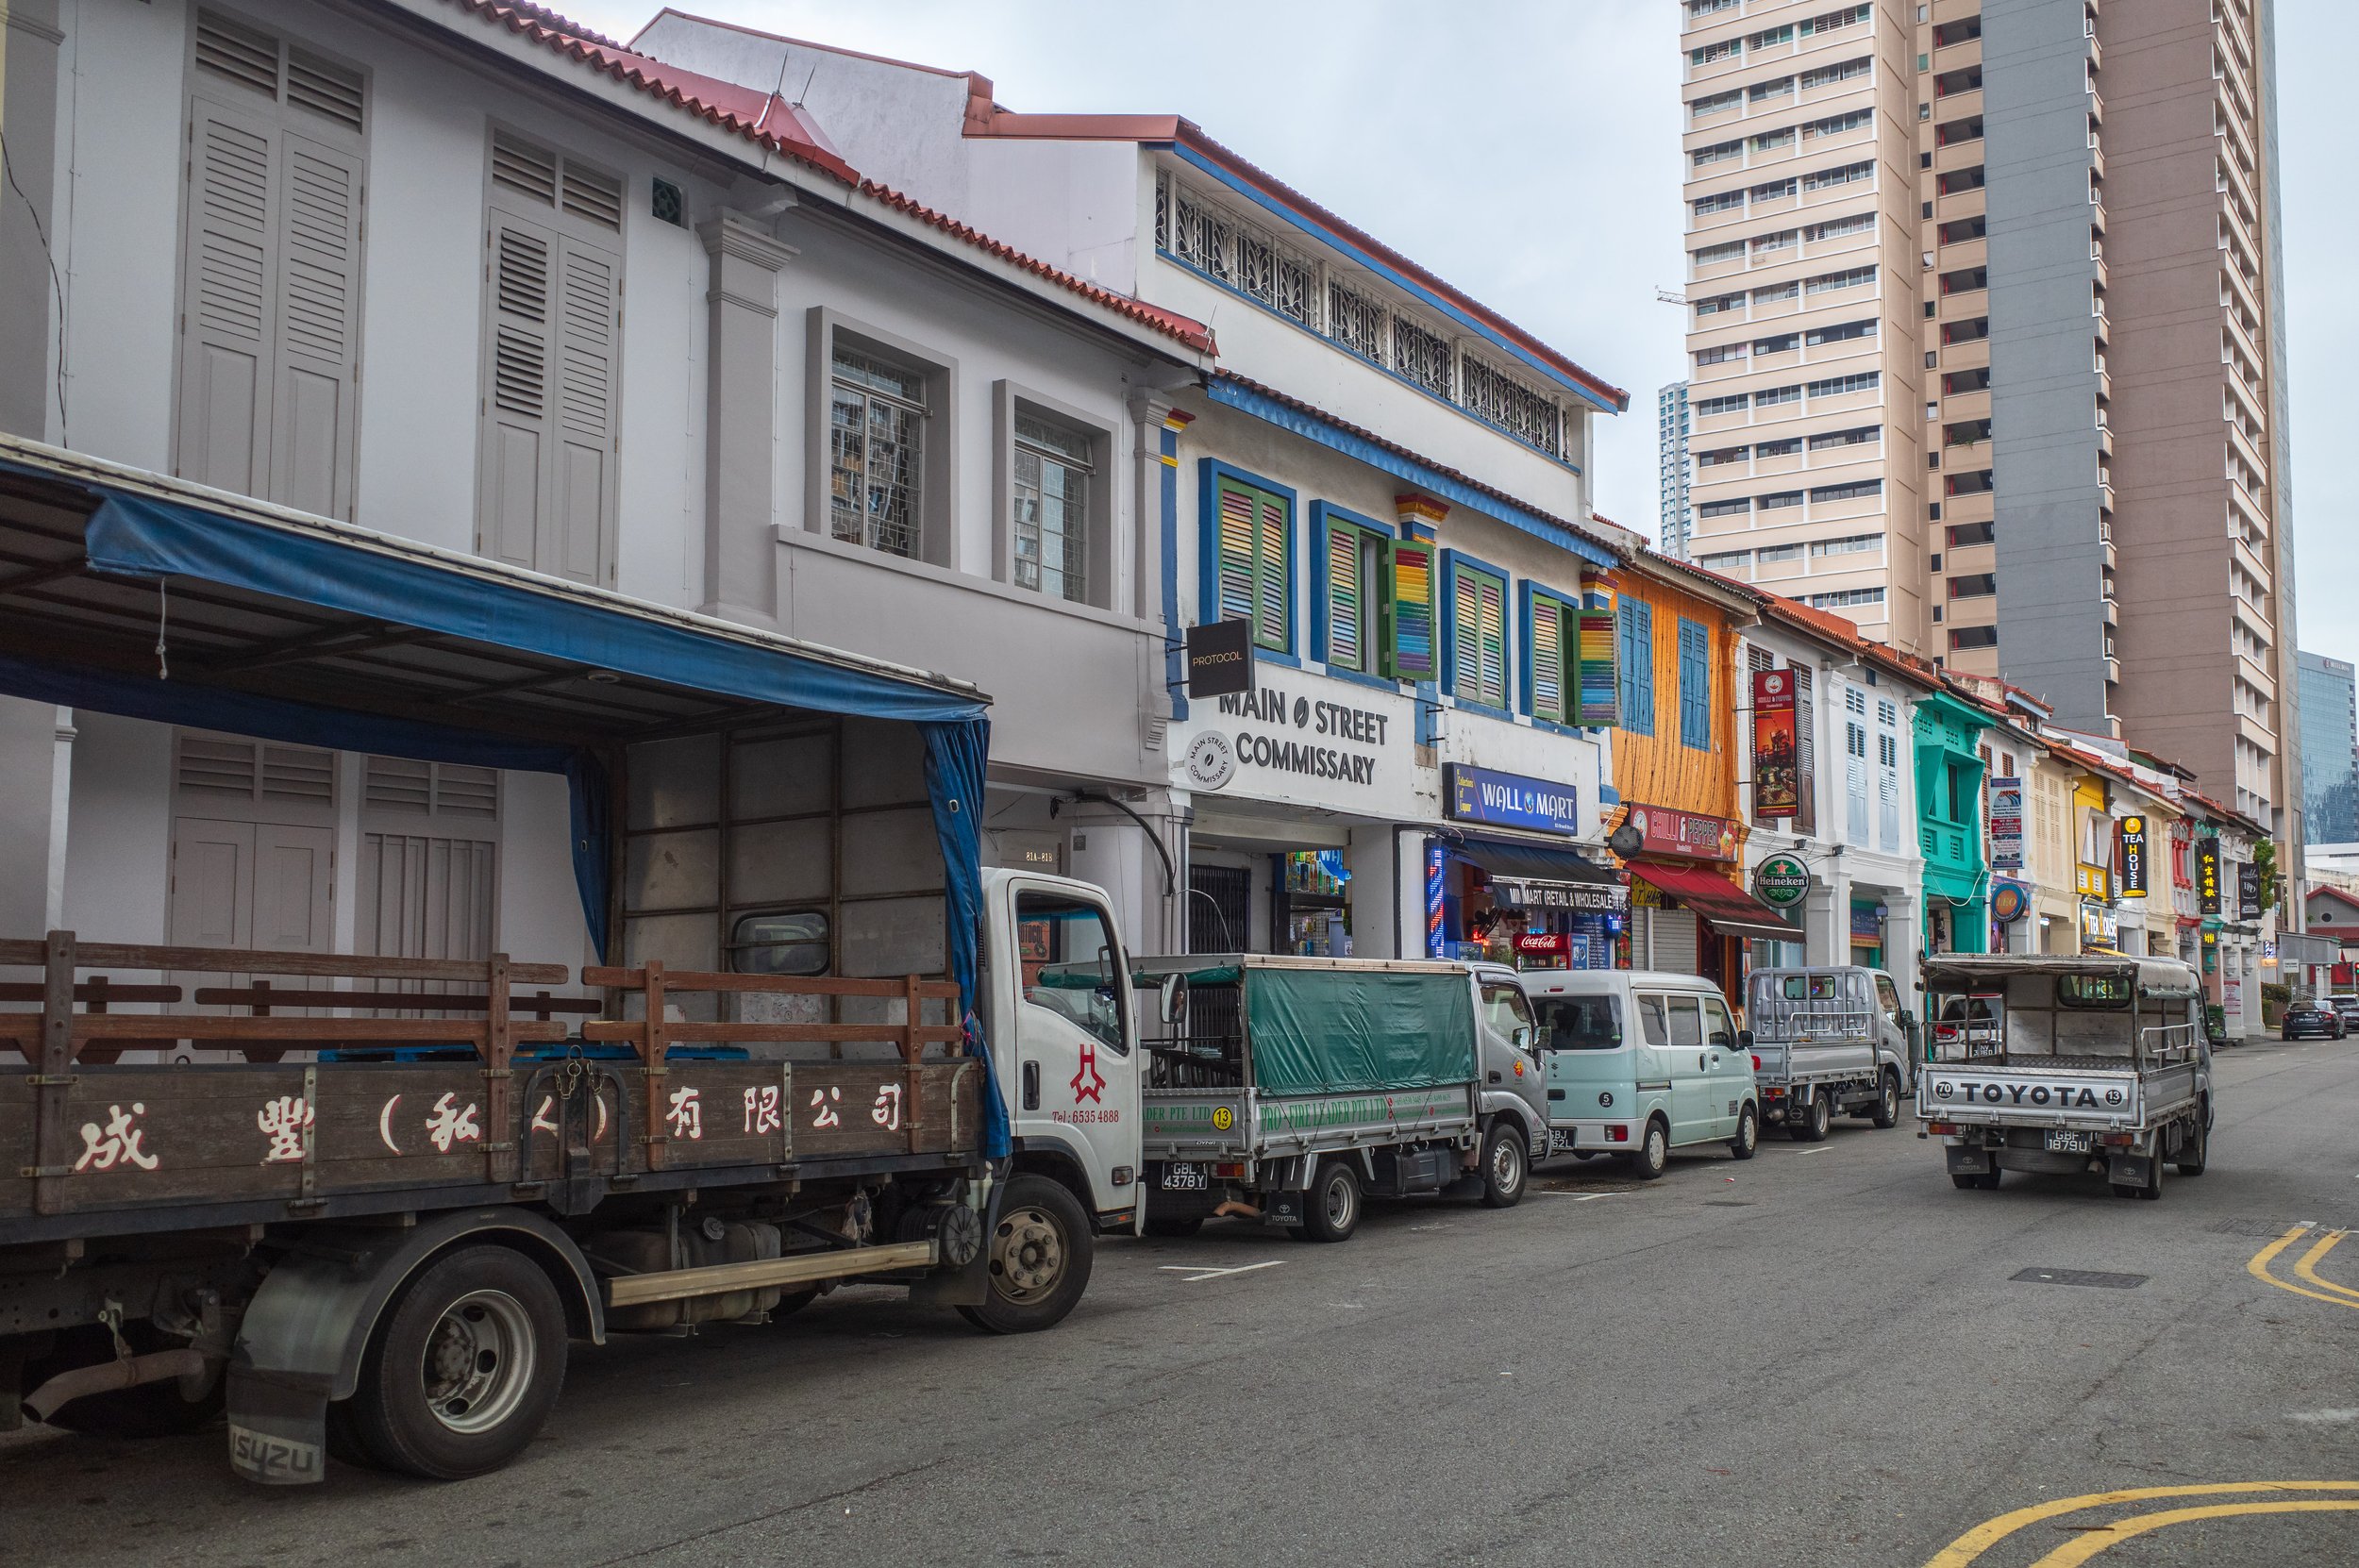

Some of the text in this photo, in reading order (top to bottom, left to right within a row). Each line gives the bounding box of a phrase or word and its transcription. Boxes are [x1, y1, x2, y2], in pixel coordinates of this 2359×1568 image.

[1193, 651, 1243, 667] PROTOCOL
[1219, 688, 1388, 745] MAIN STREET
[1190, 737, 1228, 759] MAIN STREET
[1236, 732, 1376, 785] COMMISSARY
[1190, 759, 1229, 783] COMMISSARY
[1481, 782, 1574, 821] WALL MART
[1680, 816, 1686, 842] &
[1687, 817, 1717, 846] PEPPER
[2123, 834, 2144, 843] TEA
[1026, 852, 1053, 862] 81A-81B
[2129, 844, 2139, 889] HOUSE
[1759, 876, 1806, 886] Heineken
[1570, 892, 1574, 907] &
[1998, 897, 2016, 908] LEO
[2089, 915, 2100, 935] TEA
[1521, 935, 1558, 948] Coca-Cola
[1938, 1083, 1951, 1093] 70
[2108, 1090, 2120, 1100] 13
[1603, 1094, 1610, 1103] 5
[1961, 1083, 2100, 1108] TOYOTA
[1072, 1110, 1096, 1123] 6535
[1097, 1109, 1119, 1123] 4888
[1170, 1107, 1188, 1120] PTE
[1193, 1107, 1211, 1120] LTD
[1216, 1110, 1229, 1122] 13
[1260, 1107, 1281, 1131] PRO
[1289, 1104, 1311, 1128] FIRE
[1313, 1100, 1349, 1126] LEADER
[1351, 1099, 1367, 1123] PTE
[1370, 1098, 1387, 1121] LTD
[2049, 1140, 2087, 1151] 1879U
[1173, 1162, 1196, 1175] GBL
[1163, 1175, 1204, 1188] 4378Y
[232, 1433, 313, 1473] ISUZU
